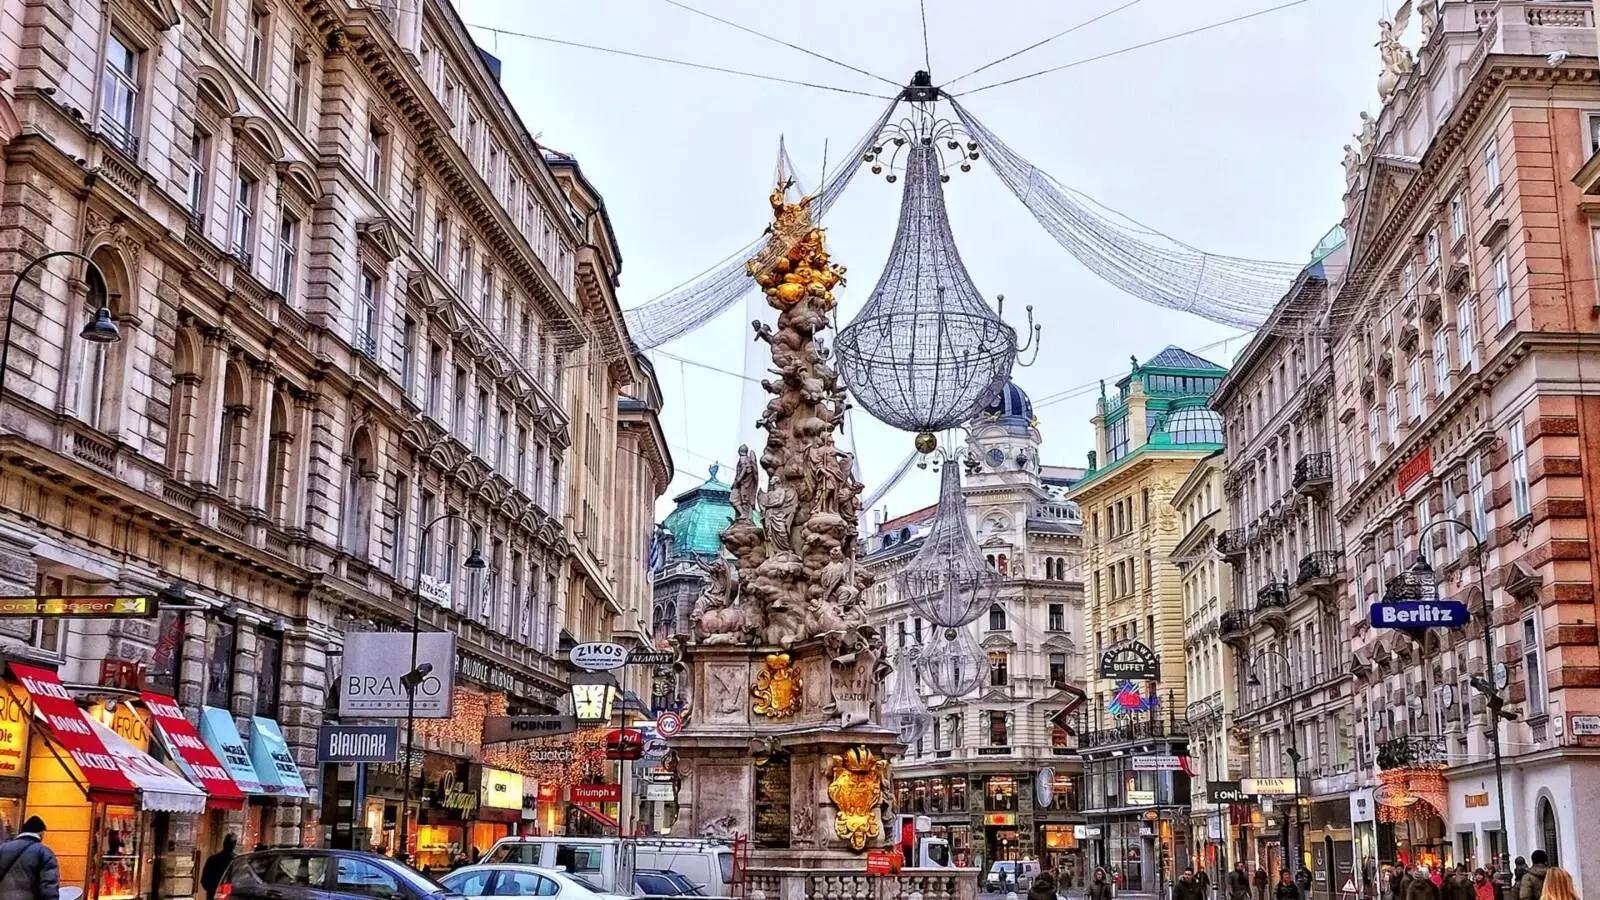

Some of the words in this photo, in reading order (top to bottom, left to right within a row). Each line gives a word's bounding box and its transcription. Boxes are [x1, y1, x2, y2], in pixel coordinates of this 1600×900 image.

[1382, 604, 1453, 622] Berlitz
[578, 645, 622, 657] ZIKOS
[1113, 663, 1145, 671] BUFFET
[48, 714, 91, 736] BOOKS
[117, 716, 149, 742] FRICK
[575, 788, 609, 798] Triumph
